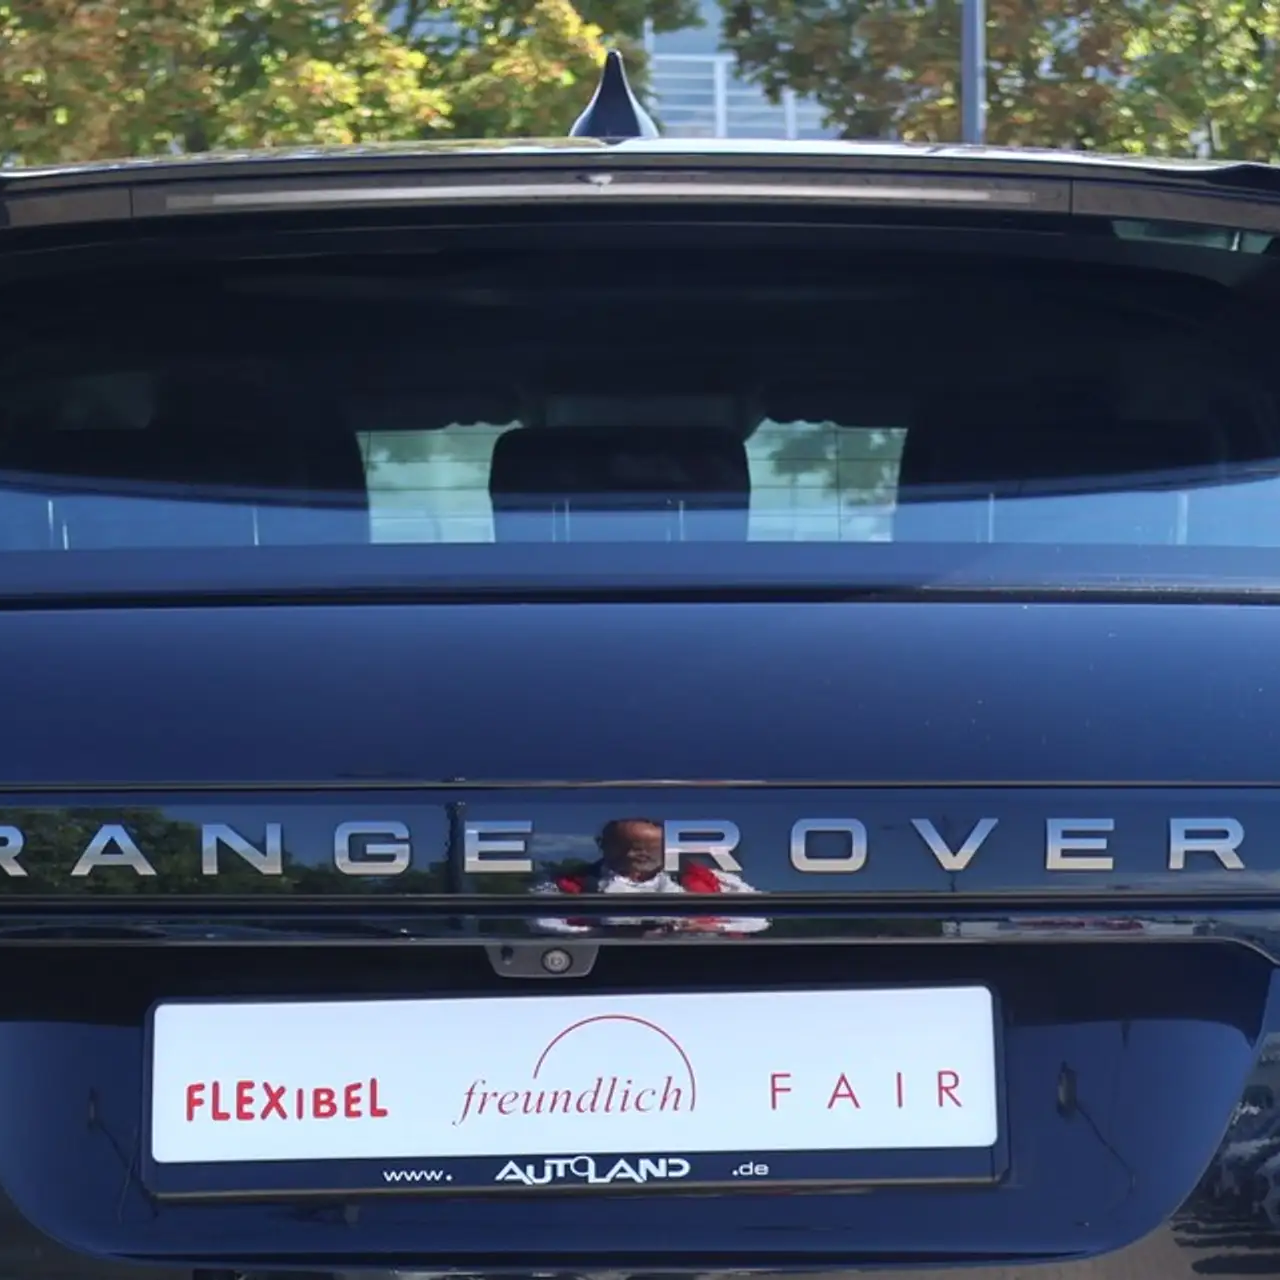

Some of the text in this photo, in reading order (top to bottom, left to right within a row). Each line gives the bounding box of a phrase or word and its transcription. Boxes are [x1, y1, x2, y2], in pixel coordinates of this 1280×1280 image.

[663, 817, 1246, 872] ROVER
[185, 1069, 963, 1127] FLEXIBEL freundlich FAIR
[382, 1155, 769, 1186] www. AUTOLAND .de
